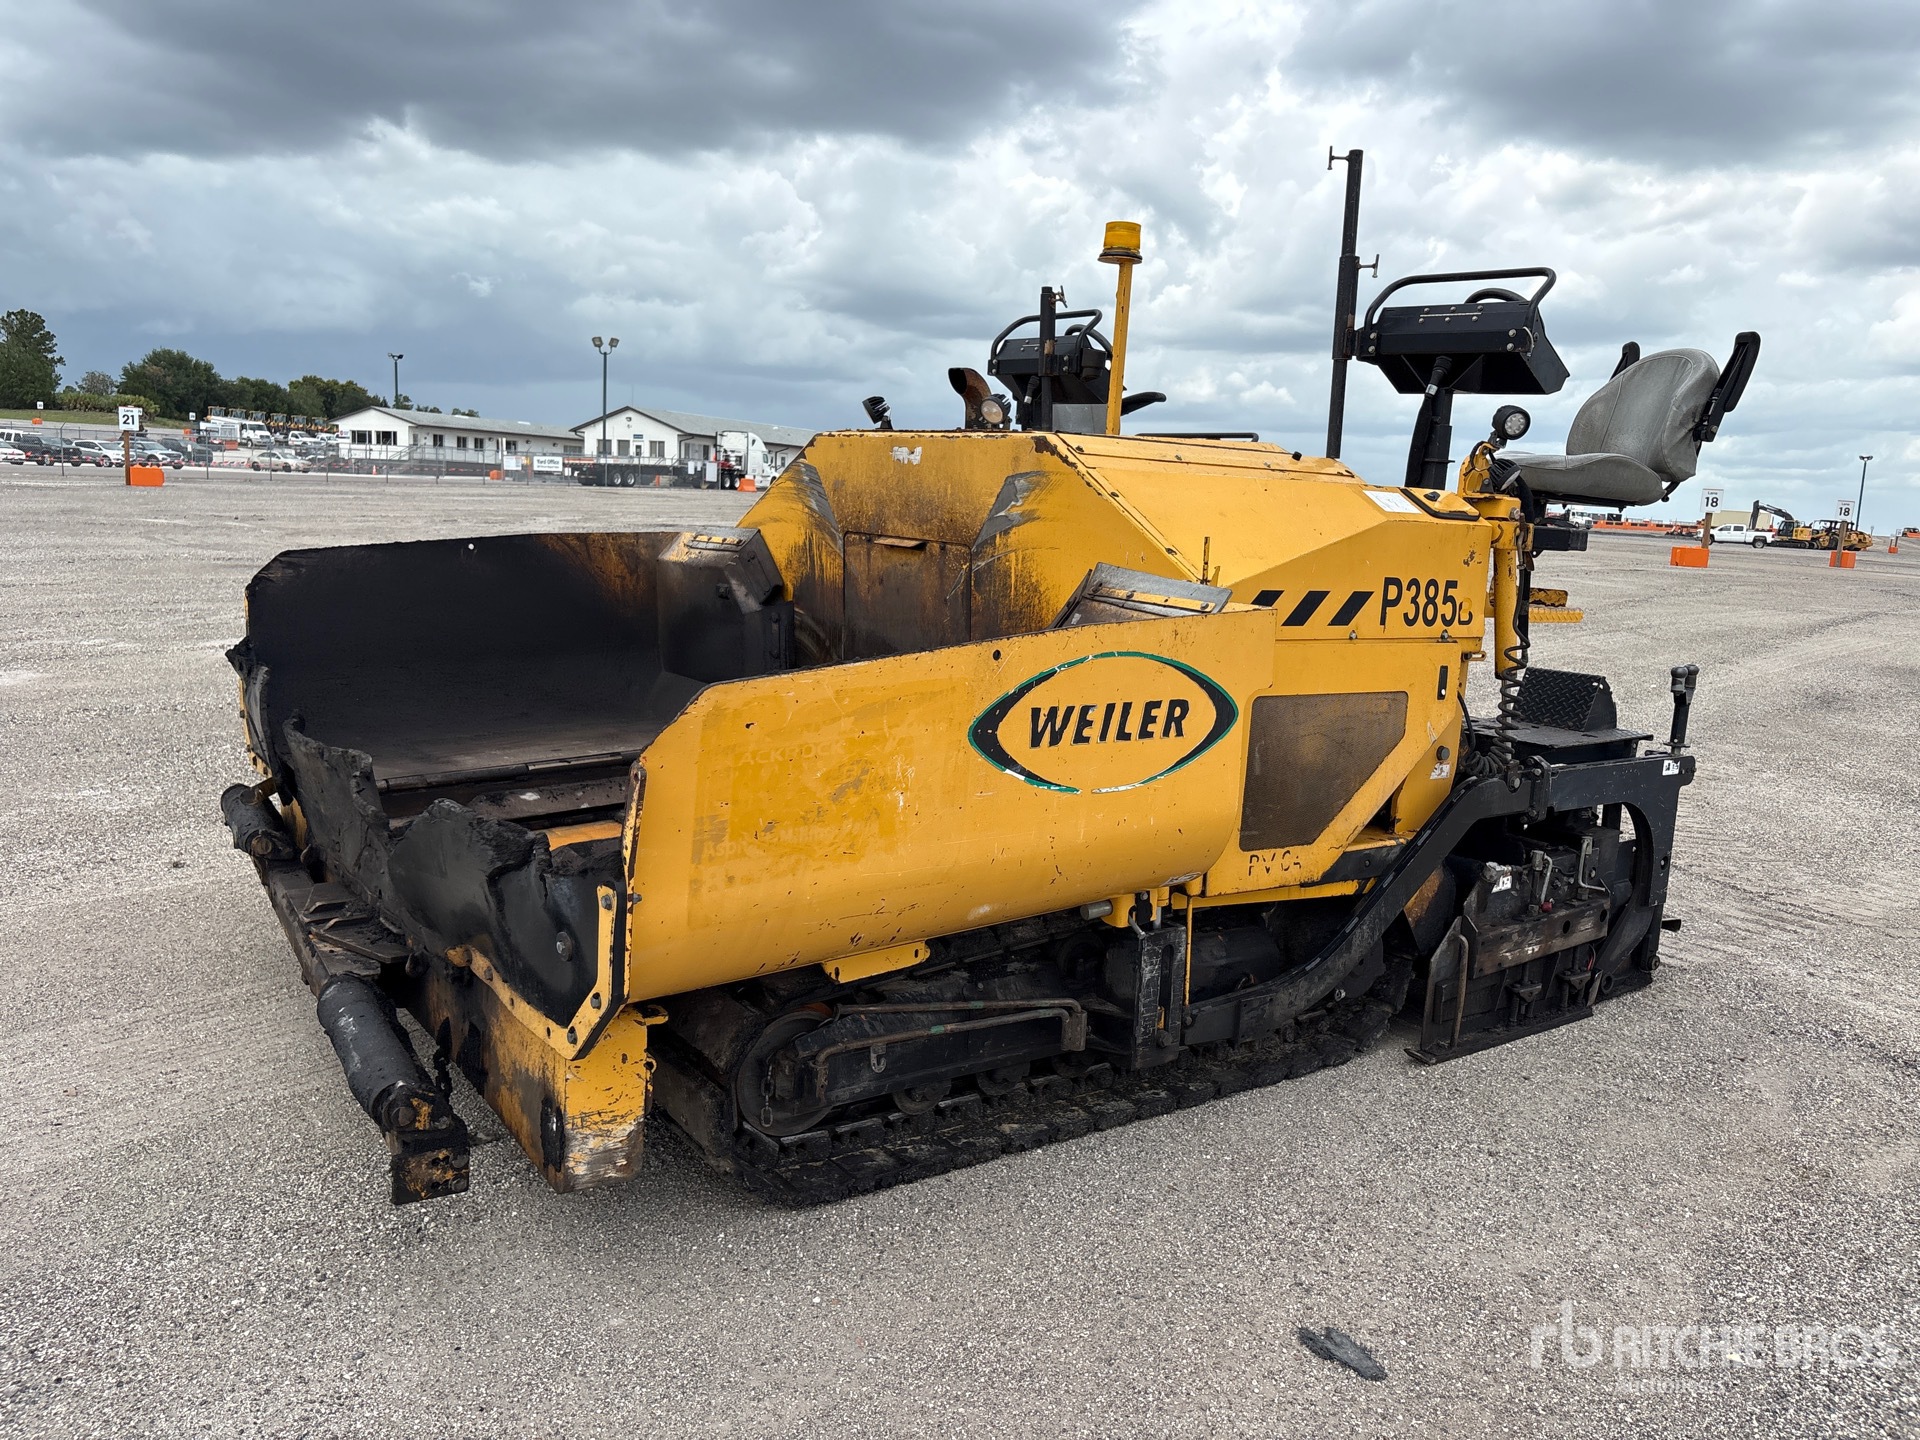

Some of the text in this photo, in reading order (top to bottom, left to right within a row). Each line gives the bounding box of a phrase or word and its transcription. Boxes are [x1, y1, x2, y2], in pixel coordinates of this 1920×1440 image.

[122, 414, 134, 425] 21
[1705, 497, 1719, 507] 18
[1838, 507, 1851, 516] 18
[1029, 699, 1190, 749] WEILER
